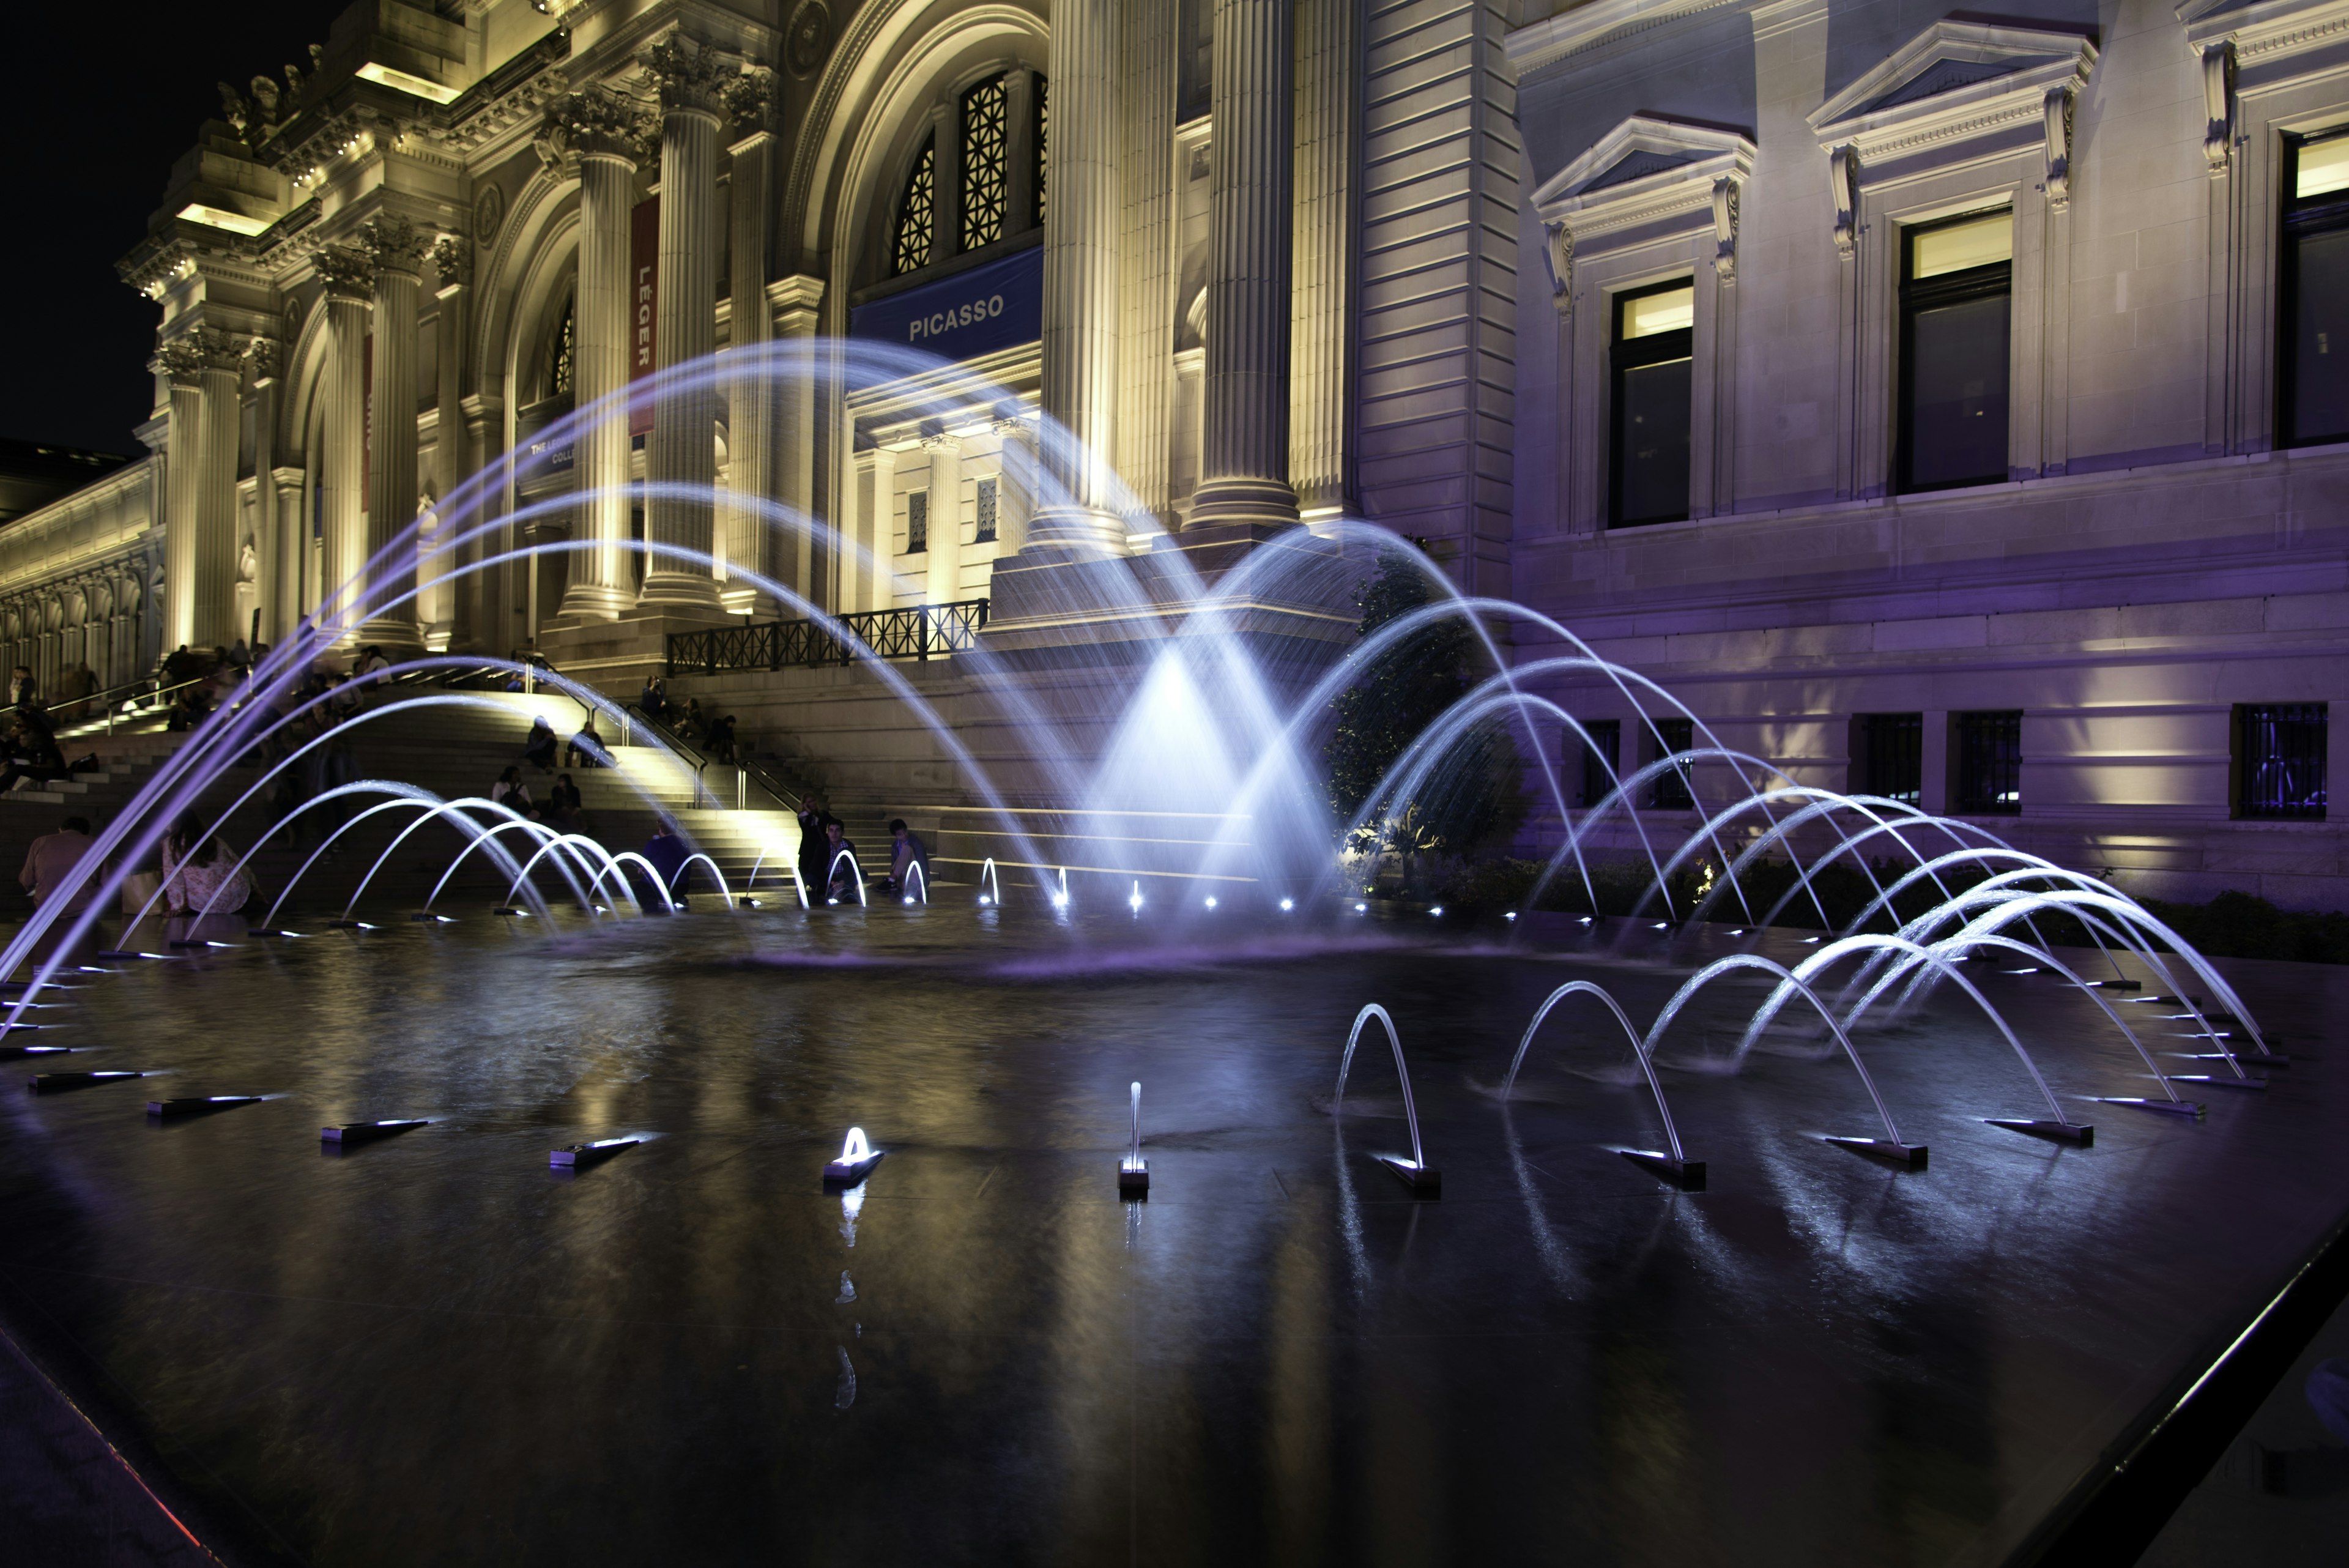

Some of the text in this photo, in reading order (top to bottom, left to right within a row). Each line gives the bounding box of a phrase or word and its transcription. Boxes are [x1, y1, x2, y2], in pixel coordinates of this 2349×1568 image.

[639, 266, 653, 366] LÉGER
[910, 294, 1004, 342] PICASSO
[530, 441, 546, 455] THE
